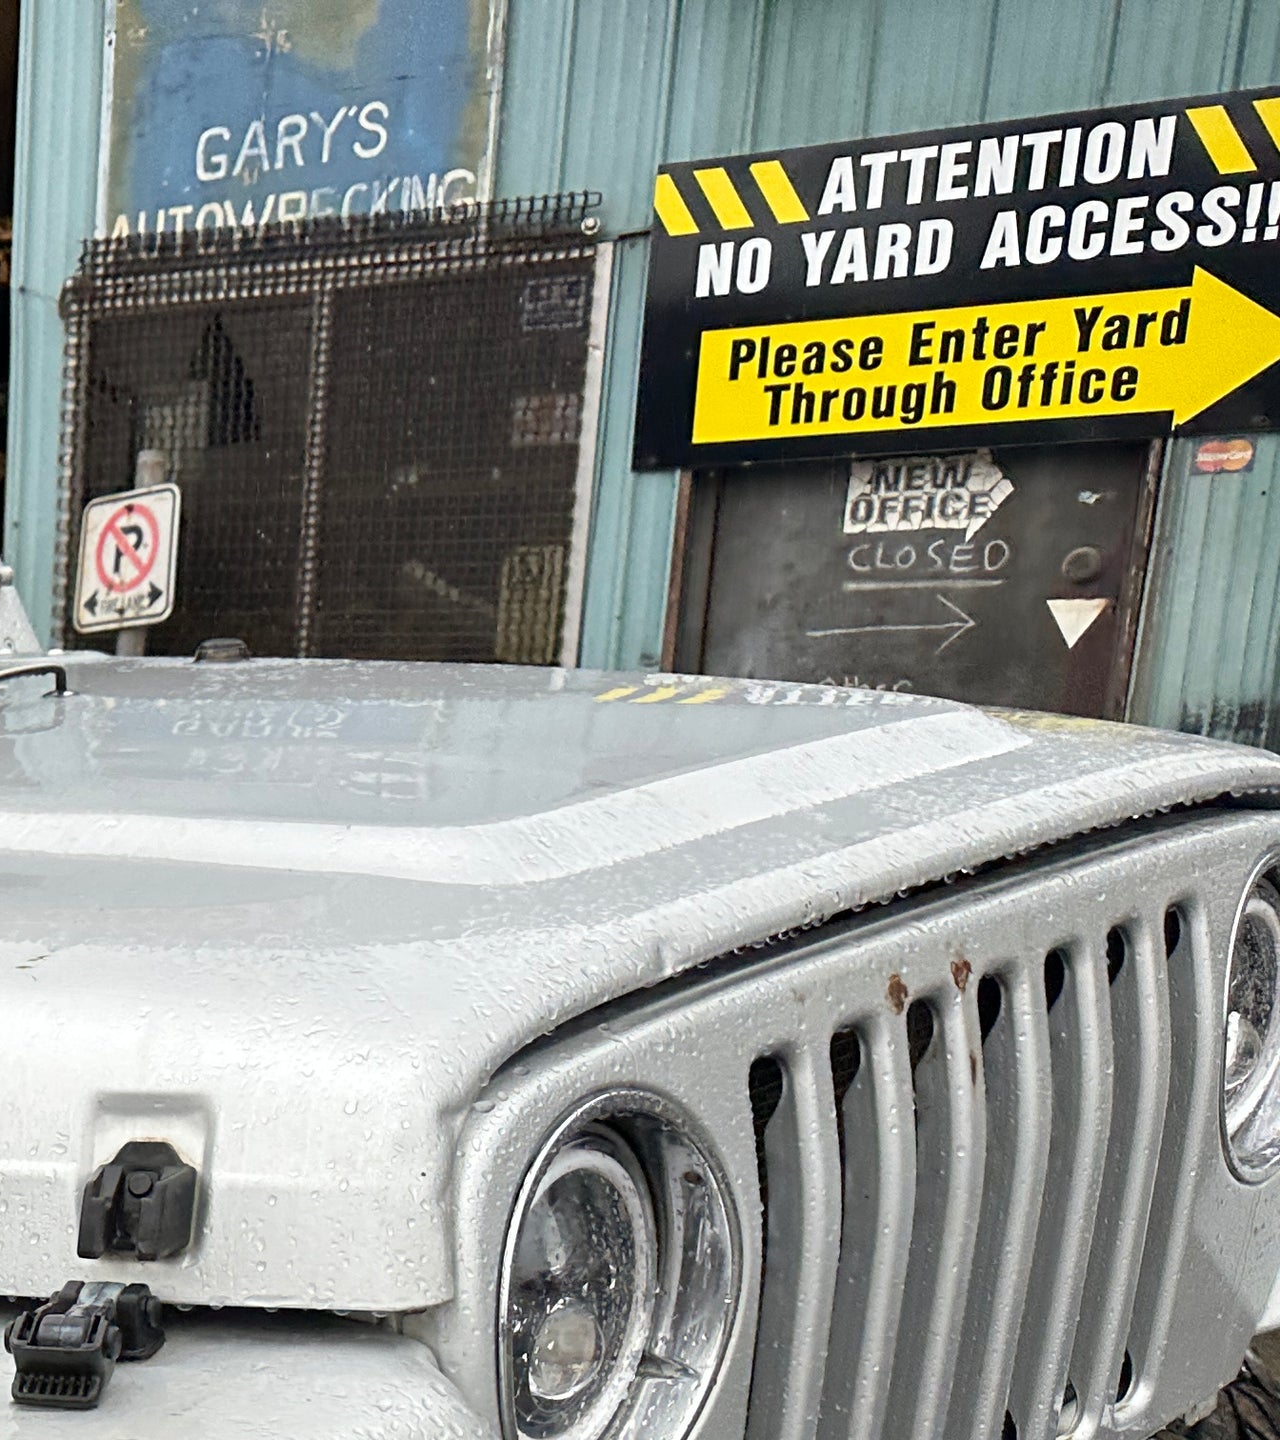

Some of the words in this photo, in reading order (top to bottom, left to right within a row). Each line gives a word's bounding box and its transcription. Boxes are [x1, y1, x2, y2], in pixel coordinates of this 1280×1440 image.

[195, 100, 390, 182] GARY'S
[817, 115, 1178, 215] ATTENTION
[695, 237, 773, 299] NO
[801, 219, 954, 287] YARD
[729, 335, 884, 382] Please
[909, 321, 1046, 365] Enter
[1074, 298, 1192, 353] Yard
[763, 374, 956, 426] Through
[981, 363, 1139, 412] Office
[850, 490, 992, 525] OFFICE
[871, 459, 973, 492] NEW
[848, 539, 1010, 571] CLOSED
